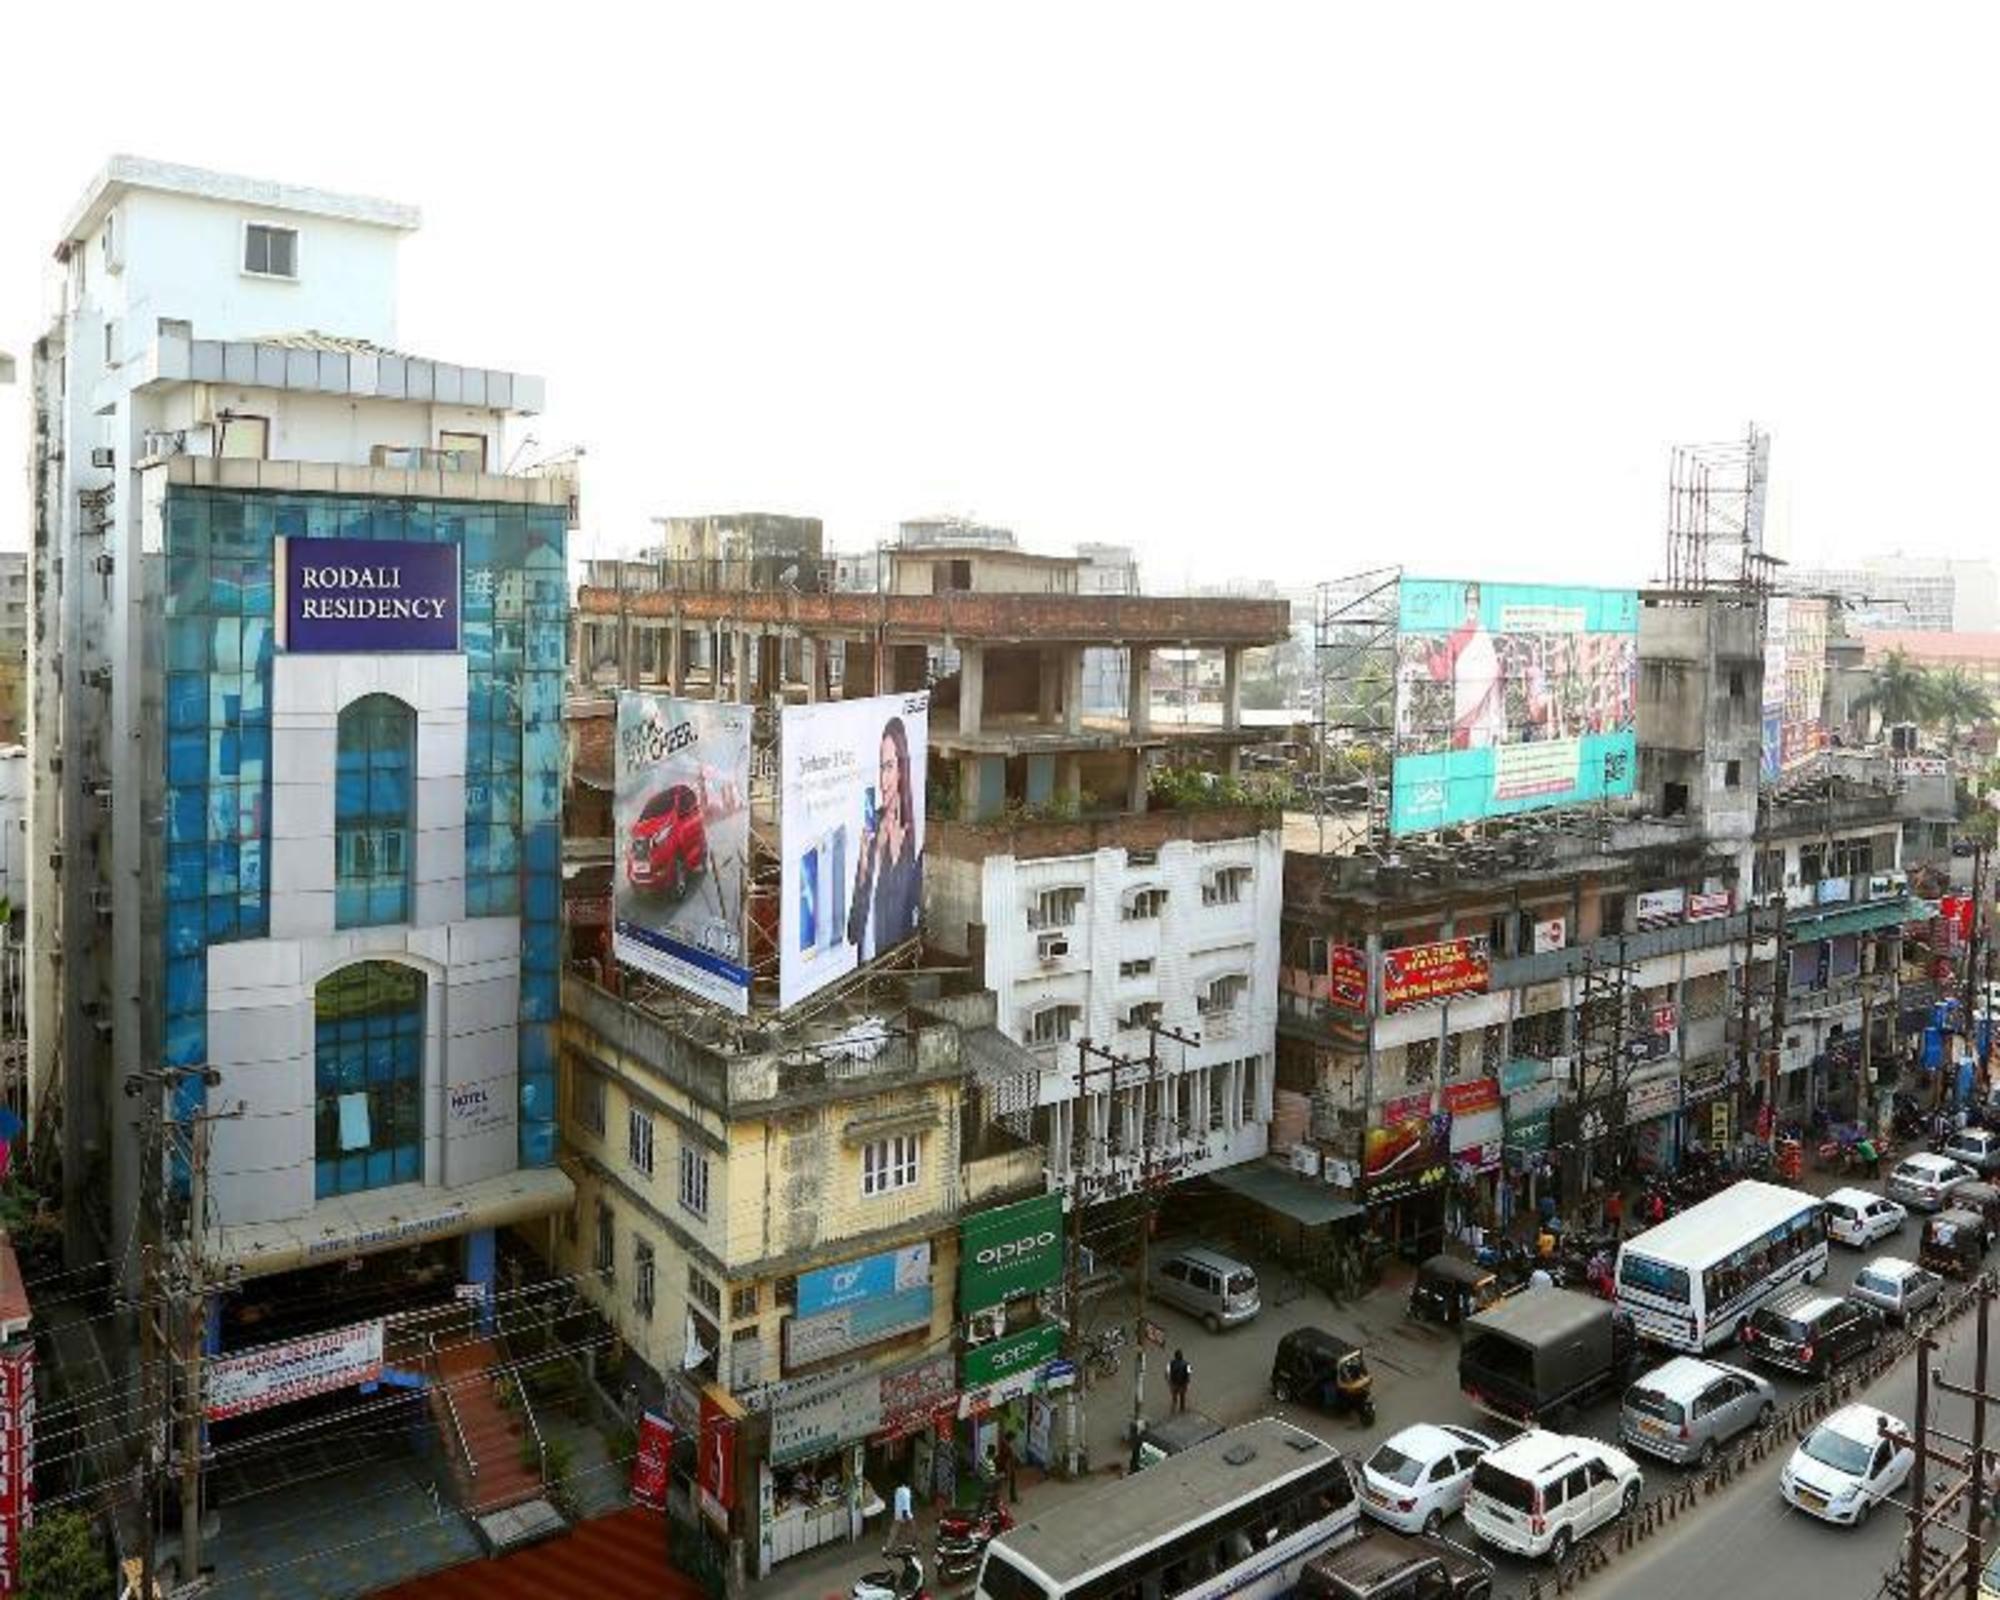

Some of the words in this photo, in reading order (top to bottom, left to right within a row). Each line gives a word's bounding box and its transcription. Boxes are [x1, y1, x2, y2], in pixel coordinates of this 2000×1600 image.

[302, 567, 401, 589] RODALI
[302, 598, 447, 620] RESIDENCY
[452, 1089, 489, 1109] HOTEL
